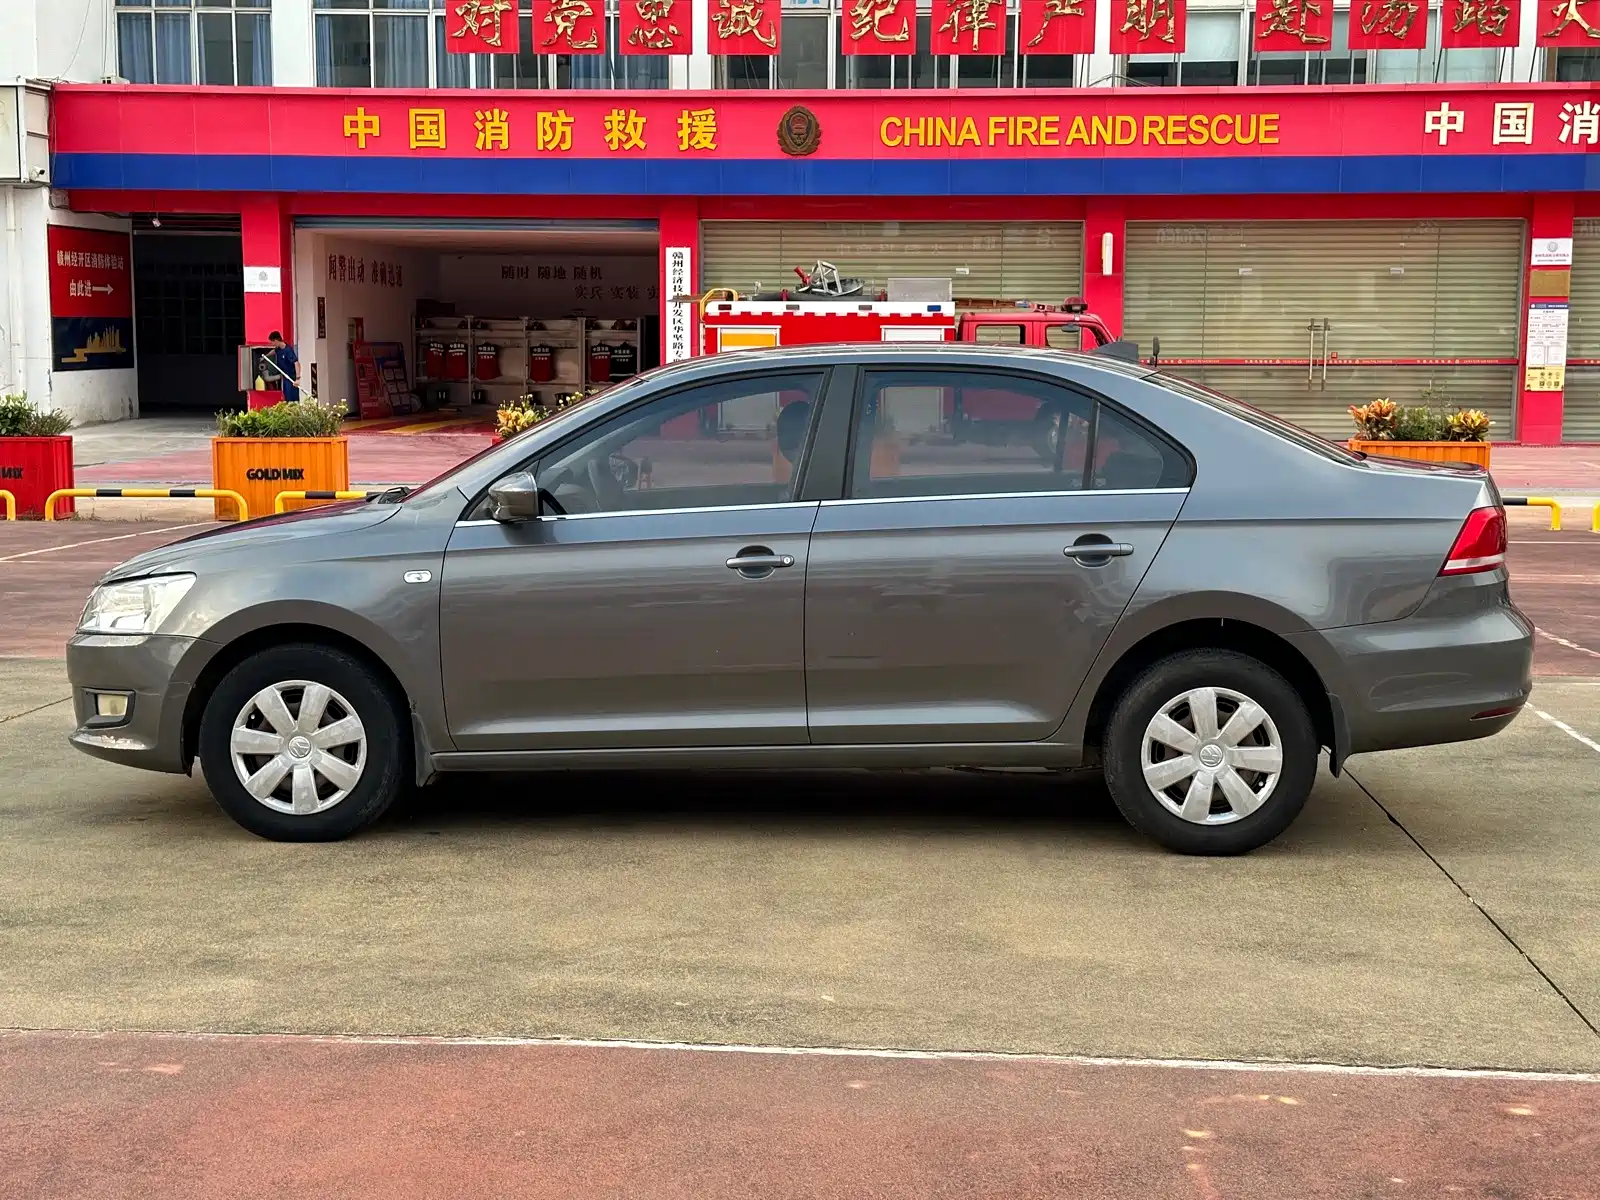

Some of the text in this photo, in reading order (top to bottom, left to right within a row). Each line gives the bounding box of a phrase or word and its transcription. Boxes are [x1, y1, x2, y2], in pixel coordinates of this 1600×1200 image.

[343, 107, 718, 151] 中国消防救援
[880, 113, 1280, 147] CHINA FIRE AND RESCUE
[1424, 100, 1600, 145] 中国消
[69, 279, 93, 297] 由此进
[246, 468, 305, 480] GOLD MIX
